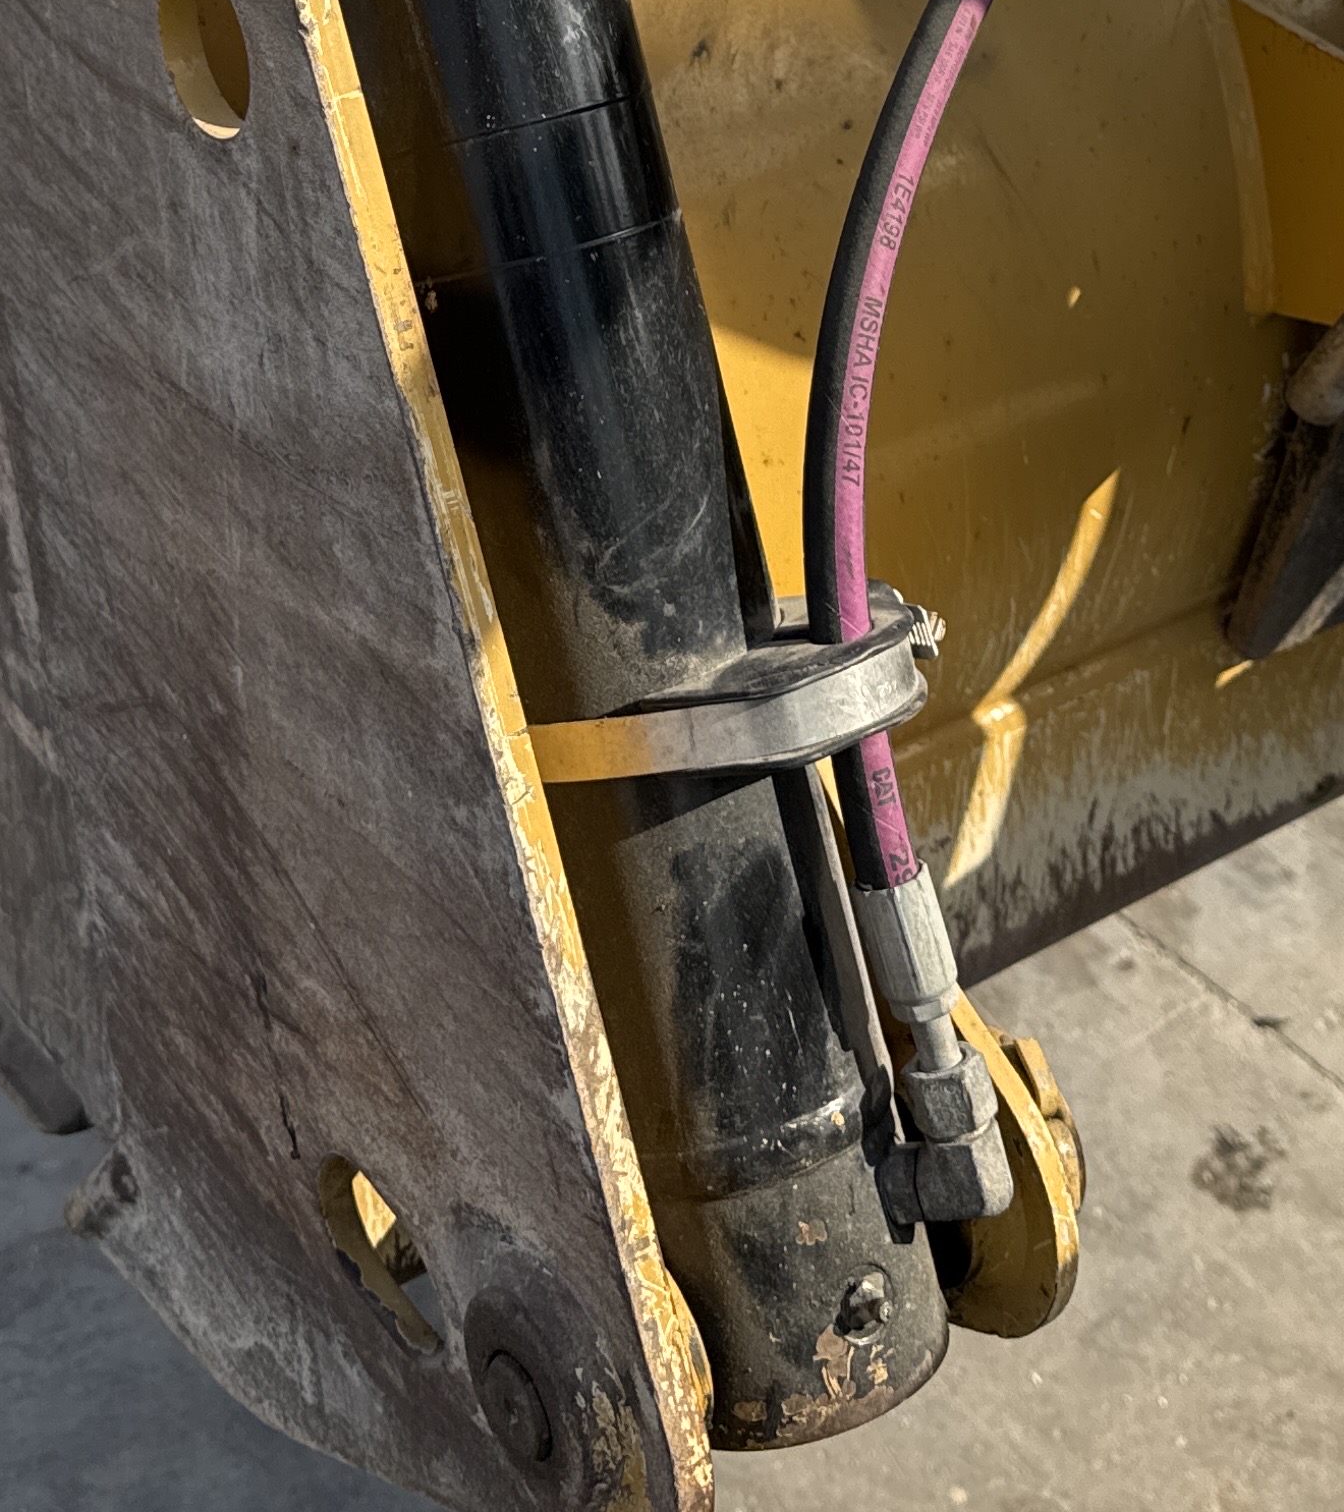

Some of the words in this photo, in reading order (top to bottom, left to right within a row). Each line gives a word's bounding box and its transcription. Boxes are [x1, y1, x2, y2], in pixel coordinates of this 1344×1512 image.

[879, 173, 915, 251] 1E4198
[853, 296, 883, 367] MSHA
[841, 375, 869, 487] IC-101/47
[872, 767, 897, 807] CAT
